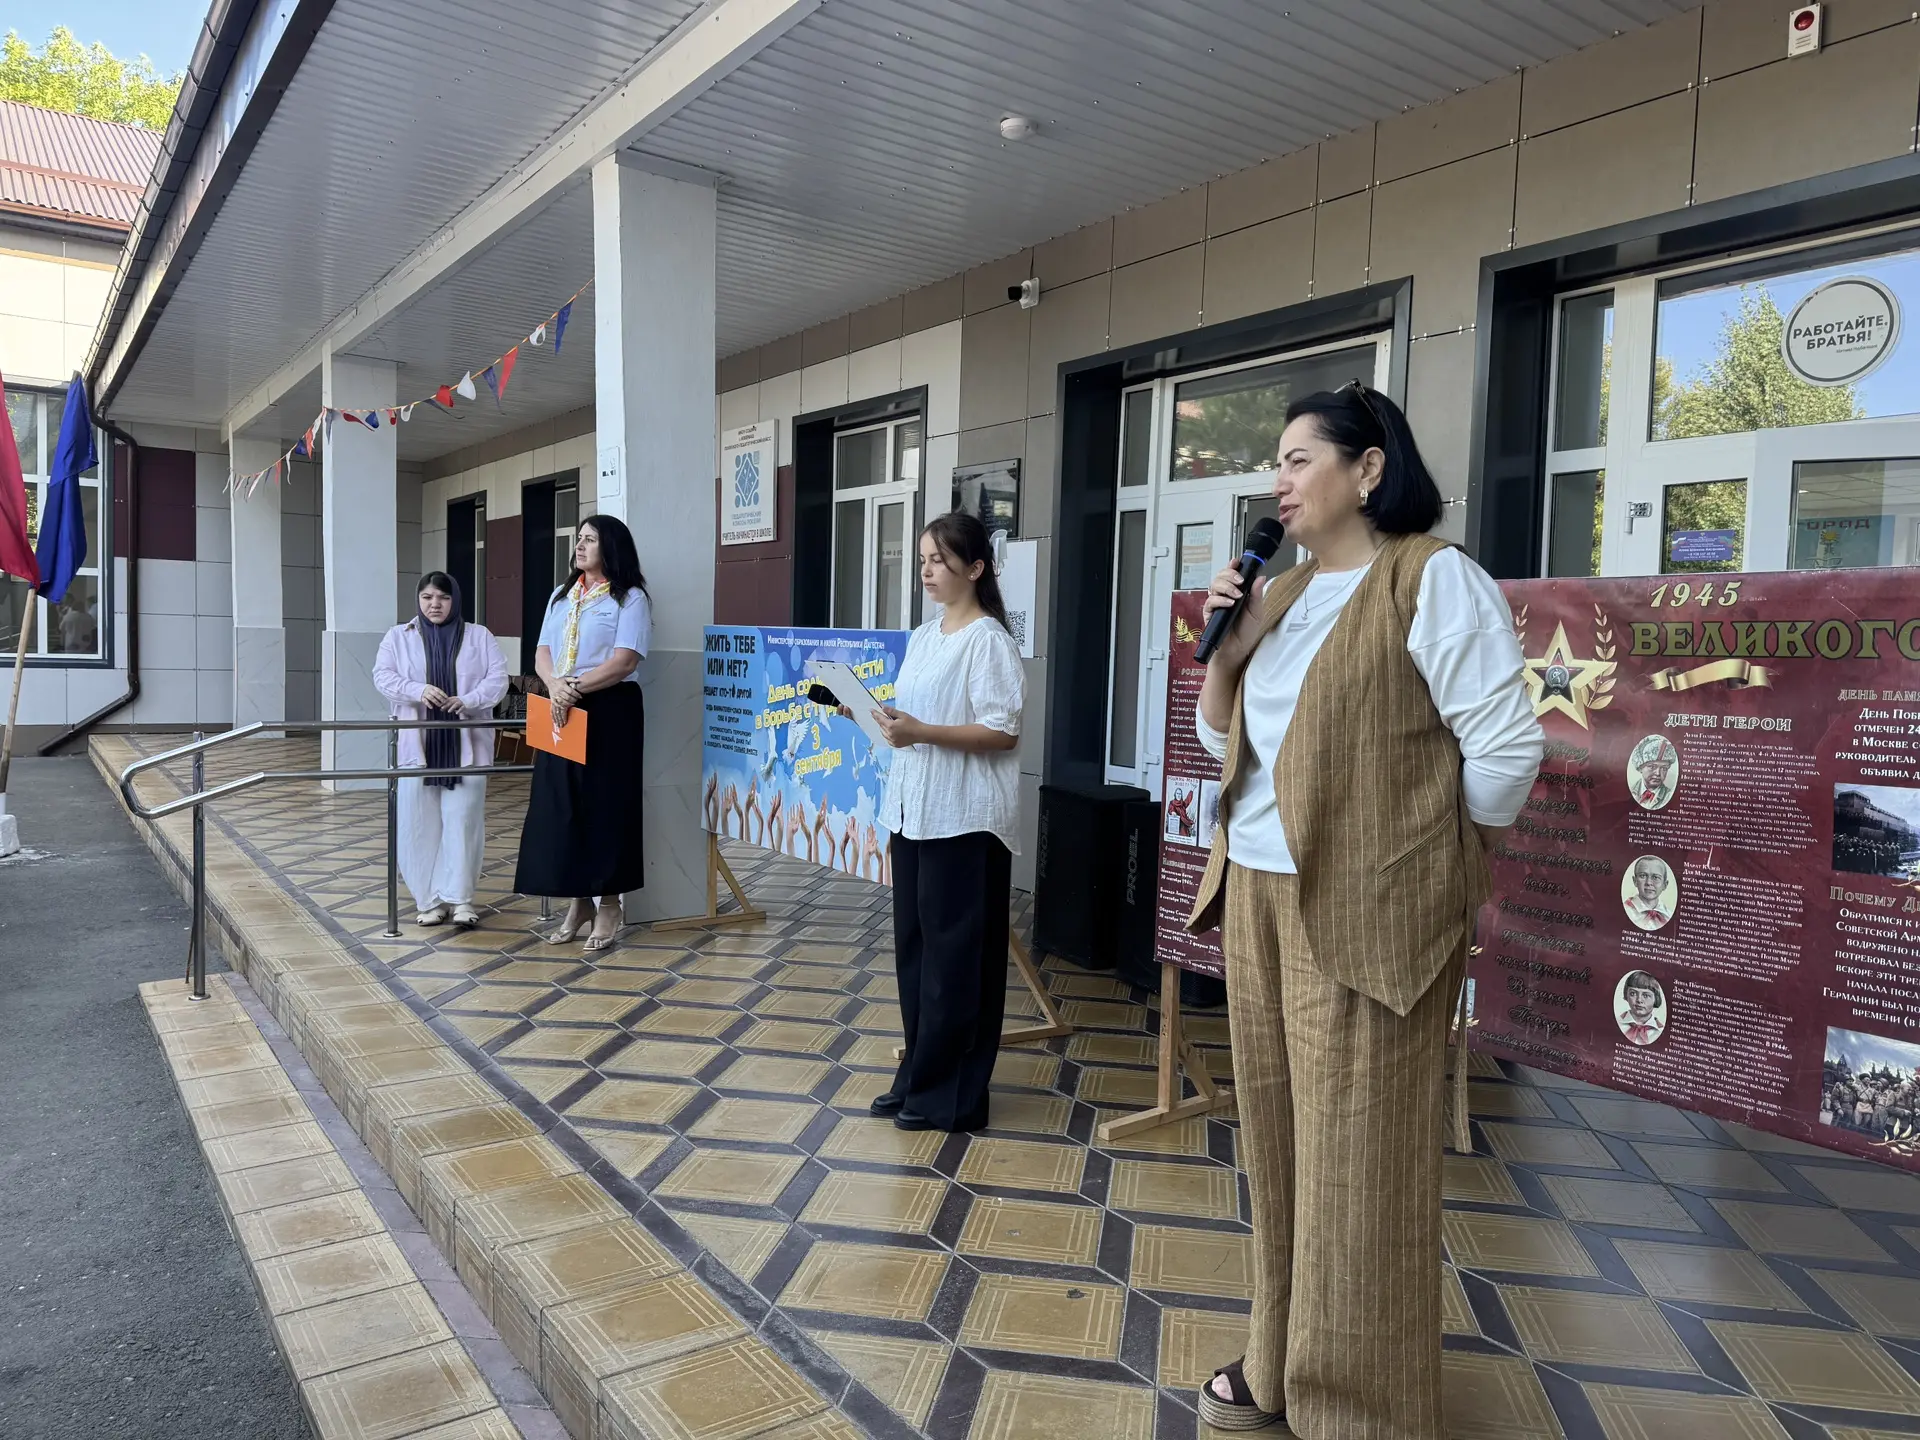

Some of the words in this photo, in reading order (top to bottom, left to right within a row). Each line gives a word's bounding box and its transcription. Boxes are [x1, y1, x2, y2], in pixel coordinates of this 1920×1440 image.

[1807, 330, 1871, 349] БРАТЬЯ!
[1650, 582, 1742, 608] 1945
[705, 634, 730, 652] ЖИТЬ
[733, 635, 755, 653] ТЕБЕ
[707, 658, 724, 676] ИЛИ
[727, 659, 748, 678] НЕТ?
[768, 684, 795, 703] День
[1882, 690, 1920, 702] ПАМ
[755, 715, 762, 729] в
[1664, 713, 1717, 728] ДЕТИ
[811, 722, 820, 750] 3
[1863, 737, 1908, 749] МОСКВЕ
[795, 747, 842, 776] сентября
[1835, 752, 1916, 764] РУКОВОДИТЕЛЬ
[1860, 767, 1909, 778] ОБЪЯВИЛ
[1127, 828, 1138, 905] PROEL
